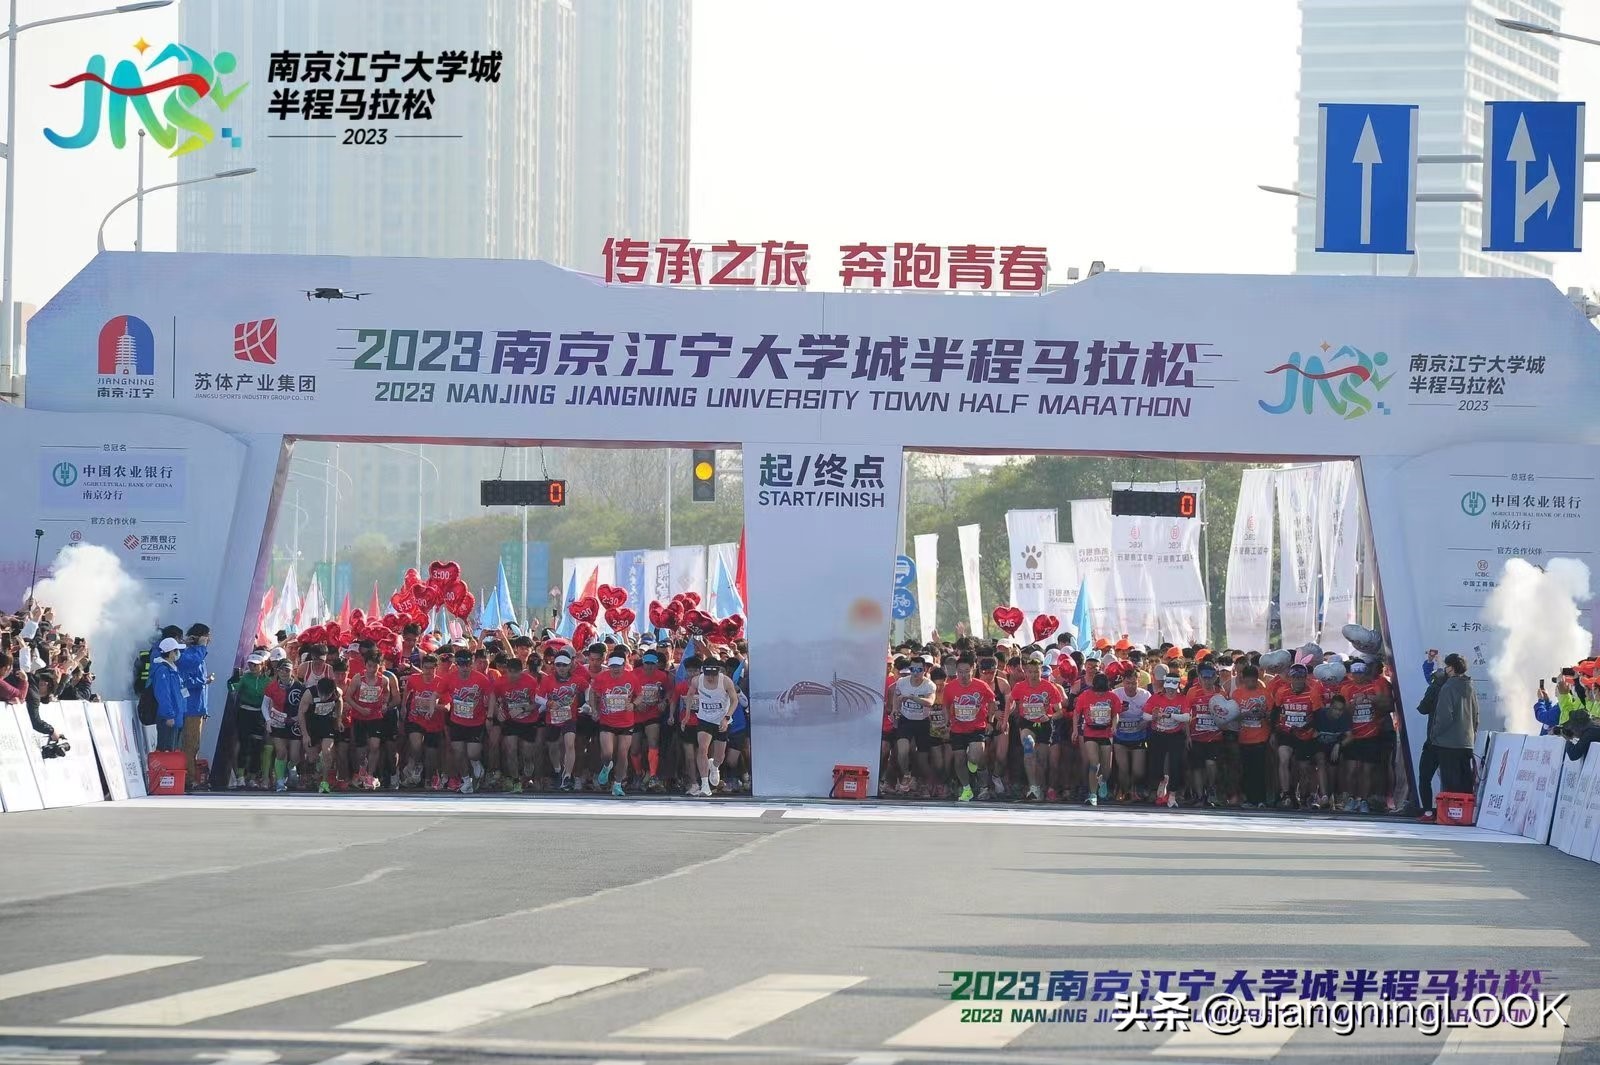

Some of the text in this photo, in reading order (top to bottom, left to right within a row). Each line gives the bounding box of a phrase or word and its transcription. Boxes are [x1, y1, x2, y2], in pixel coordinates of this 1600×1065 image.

[602, 237, 1047, 291] 传承之旅 奔跑青春
[353, 327, 1200, 388] 2023南京江宁大学城半程马拉松
[1409, 353, 1546, 375] 南京江宁大学城
[97, 377, 155, 386] JIANGNING
[194, 372, 316, 393] 苏体产业集团
[1408, 375, 1505, 395] 半程马拉松
[374, 382, 1191, 417] 2023 NANJING JIANGNING UNIVERSITY TOWN HALF MARATHON
[1458, 400, 1489, 412] 2023
[103, 443, 127, 452] 总冠名
[83, 464, 173, 479] 中国农业银行
[758, 452, 885, 489] 起/终点
[1510, 473, 1535, 481] 总冠名
[82, 490, 122, 500] 南京分行
[550, 482, 562, 503] 0
[758, 490, 885, 508] START/FINISH
[1180, 494, 1194, 516] 0
[1491, 493, 1582, 509] 中国农业银行
[90, 517, 137, 526] 官方合作伙伴
[1491, 520, 1532, 530] 南京分行
[140, 535, 176, 544] 浙商银行
[140, 543, 176, 551] CZBANK
[1497, 546, 1542, 556] 官方合作伙伴
[602, 595, 619, 605] 2:30
[575, 608, 593, 620] 2:30
[612, 619, 629, 627] 2:30
